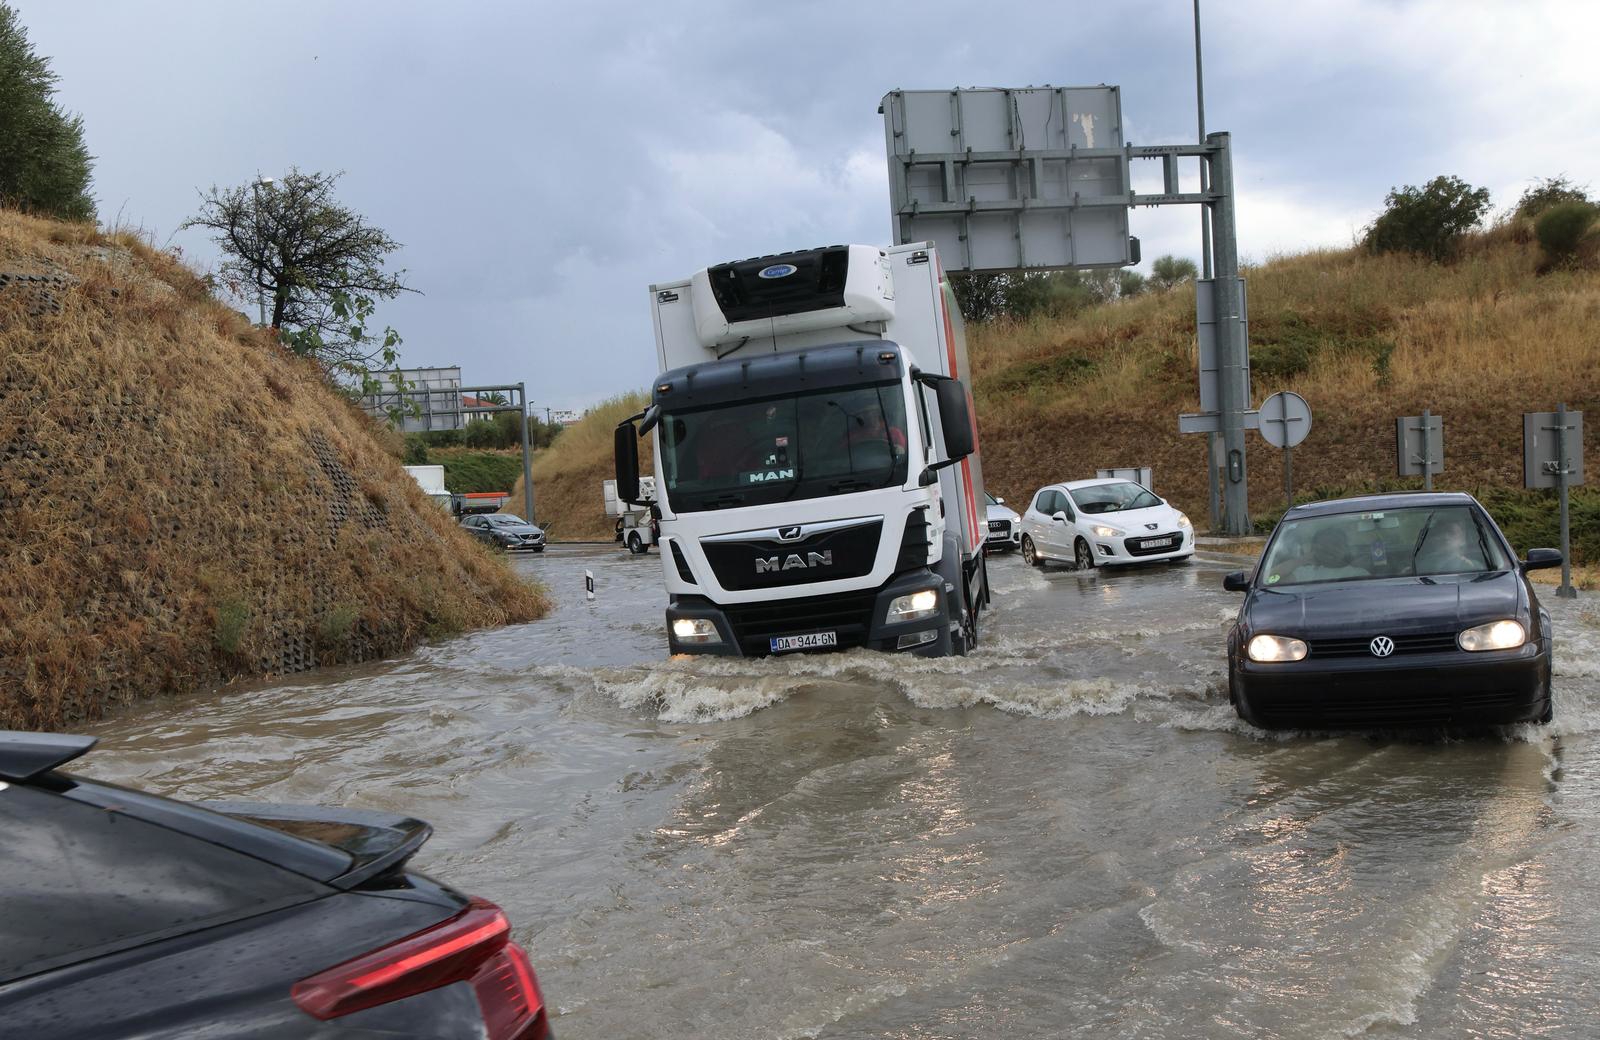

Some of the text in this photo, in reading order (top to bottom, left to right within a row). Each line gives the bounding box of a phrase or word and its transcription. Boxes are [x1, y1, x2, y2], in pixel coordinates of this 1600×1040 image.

[750, 469, 793, 482] MAN
[755, 550, 833, 573] MAN
[777, 633, 835, 649] DA 944-GN
[1371, 637, 1393, 656] VW
